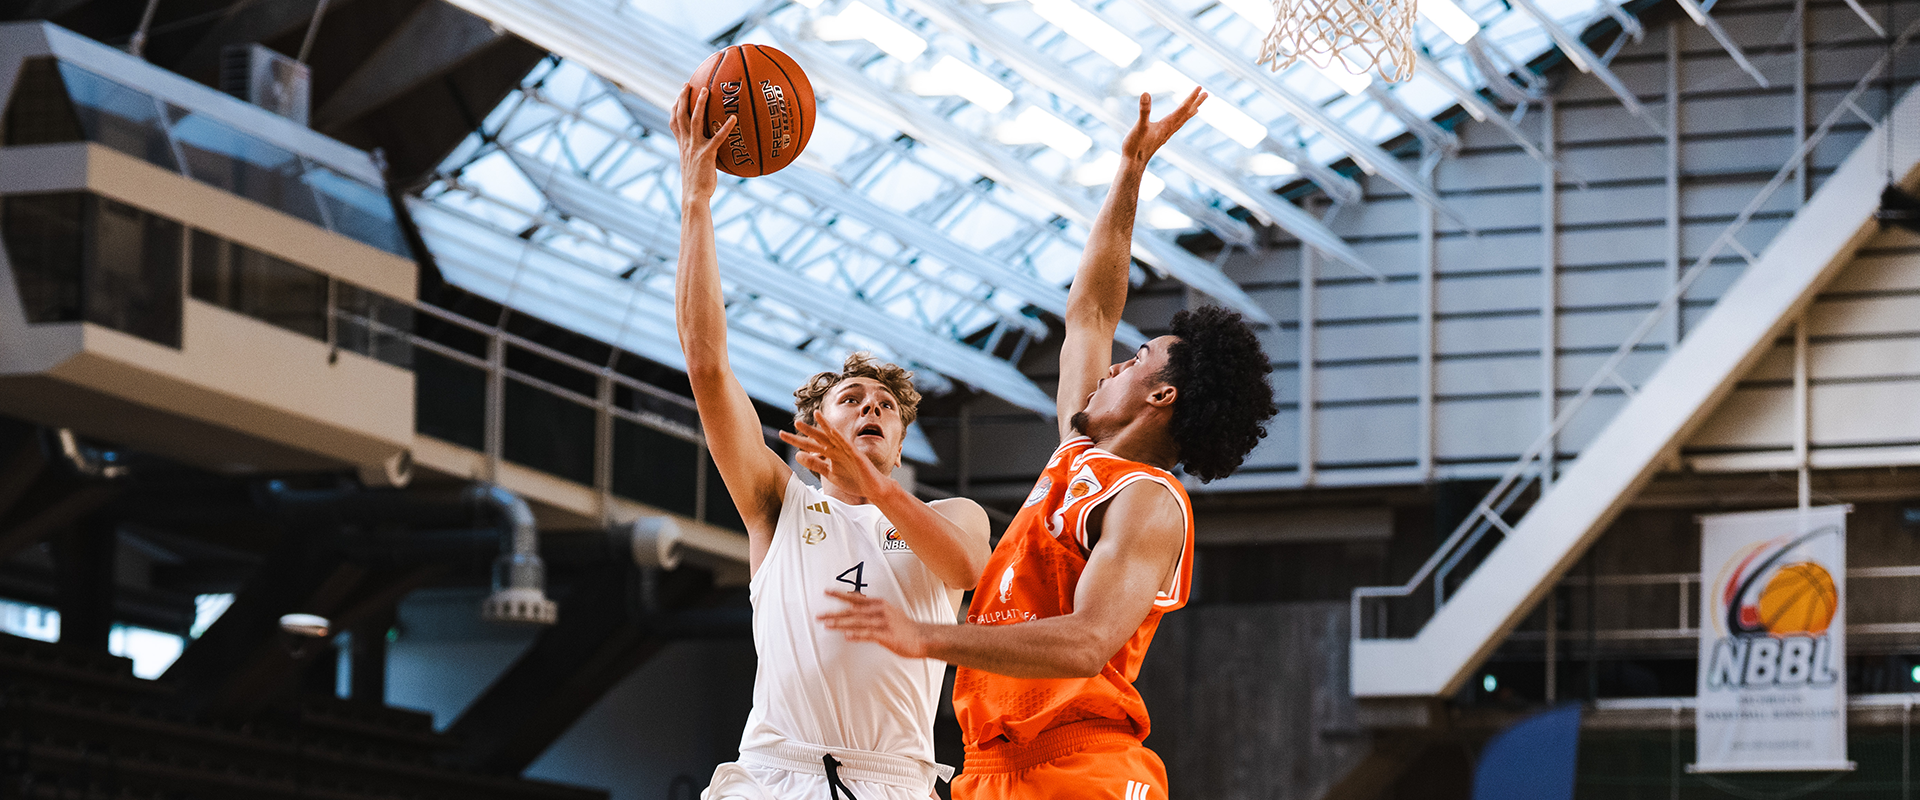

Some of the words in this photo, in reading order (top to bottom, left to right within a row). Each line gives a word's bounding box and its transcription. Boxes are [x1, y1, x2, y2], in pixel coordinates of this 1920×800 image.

[720, 80, 755, 166] SPALING
[759, 79, 783, 158] PRECISION
[835, 560, 869, 598] 4
[1706, 637, 1838, 692] NBBL
